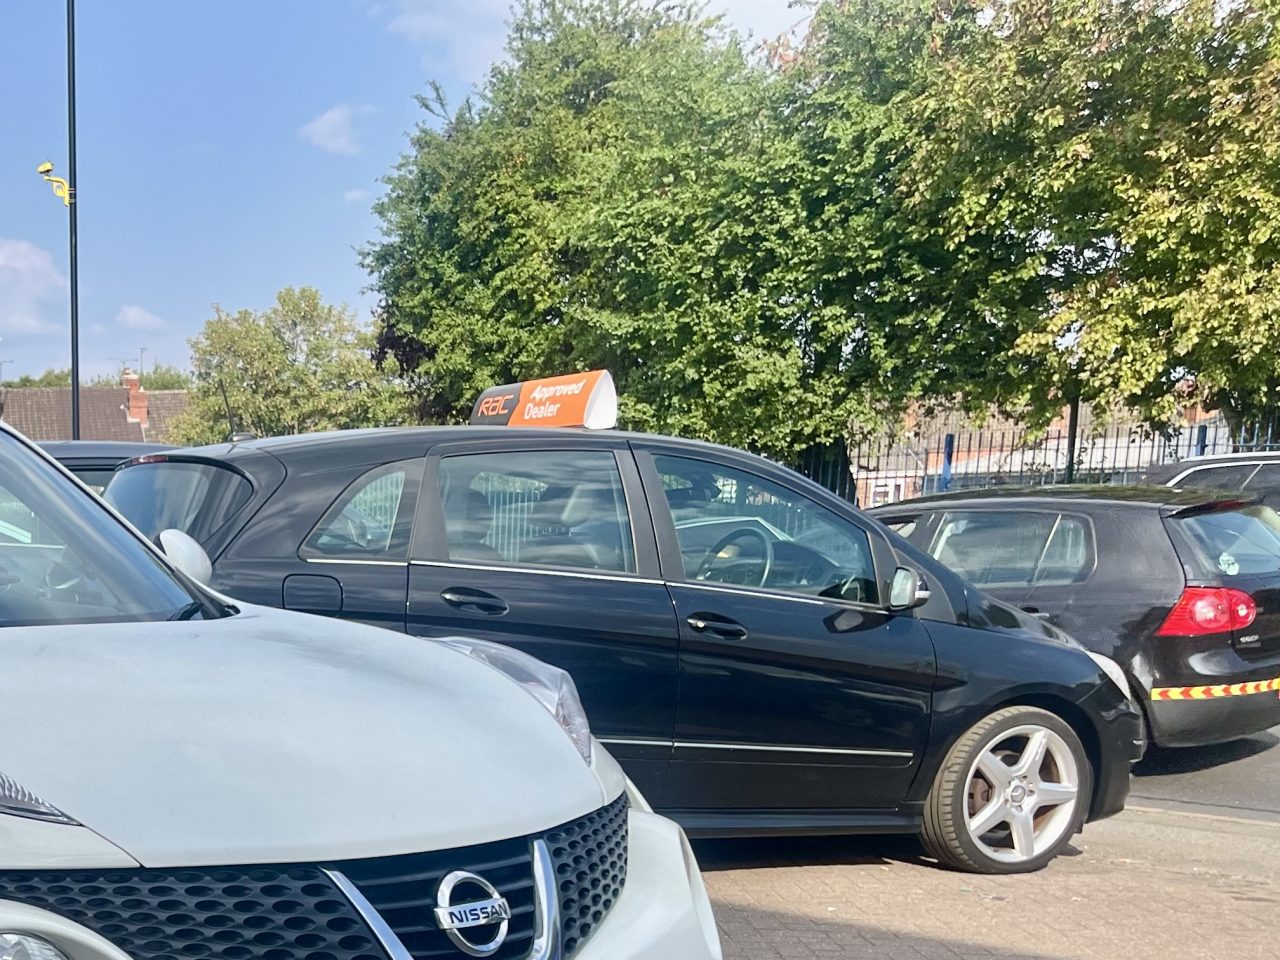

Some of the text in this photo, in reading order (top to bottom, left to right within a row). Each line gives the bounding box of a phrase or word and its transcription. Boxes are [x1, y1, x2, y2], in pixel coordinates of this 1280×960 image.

[530, 379, 586, 402] Approved
[524, 403, 561, 419] Dealer
[448, 901, 508, 924] NISSAN
